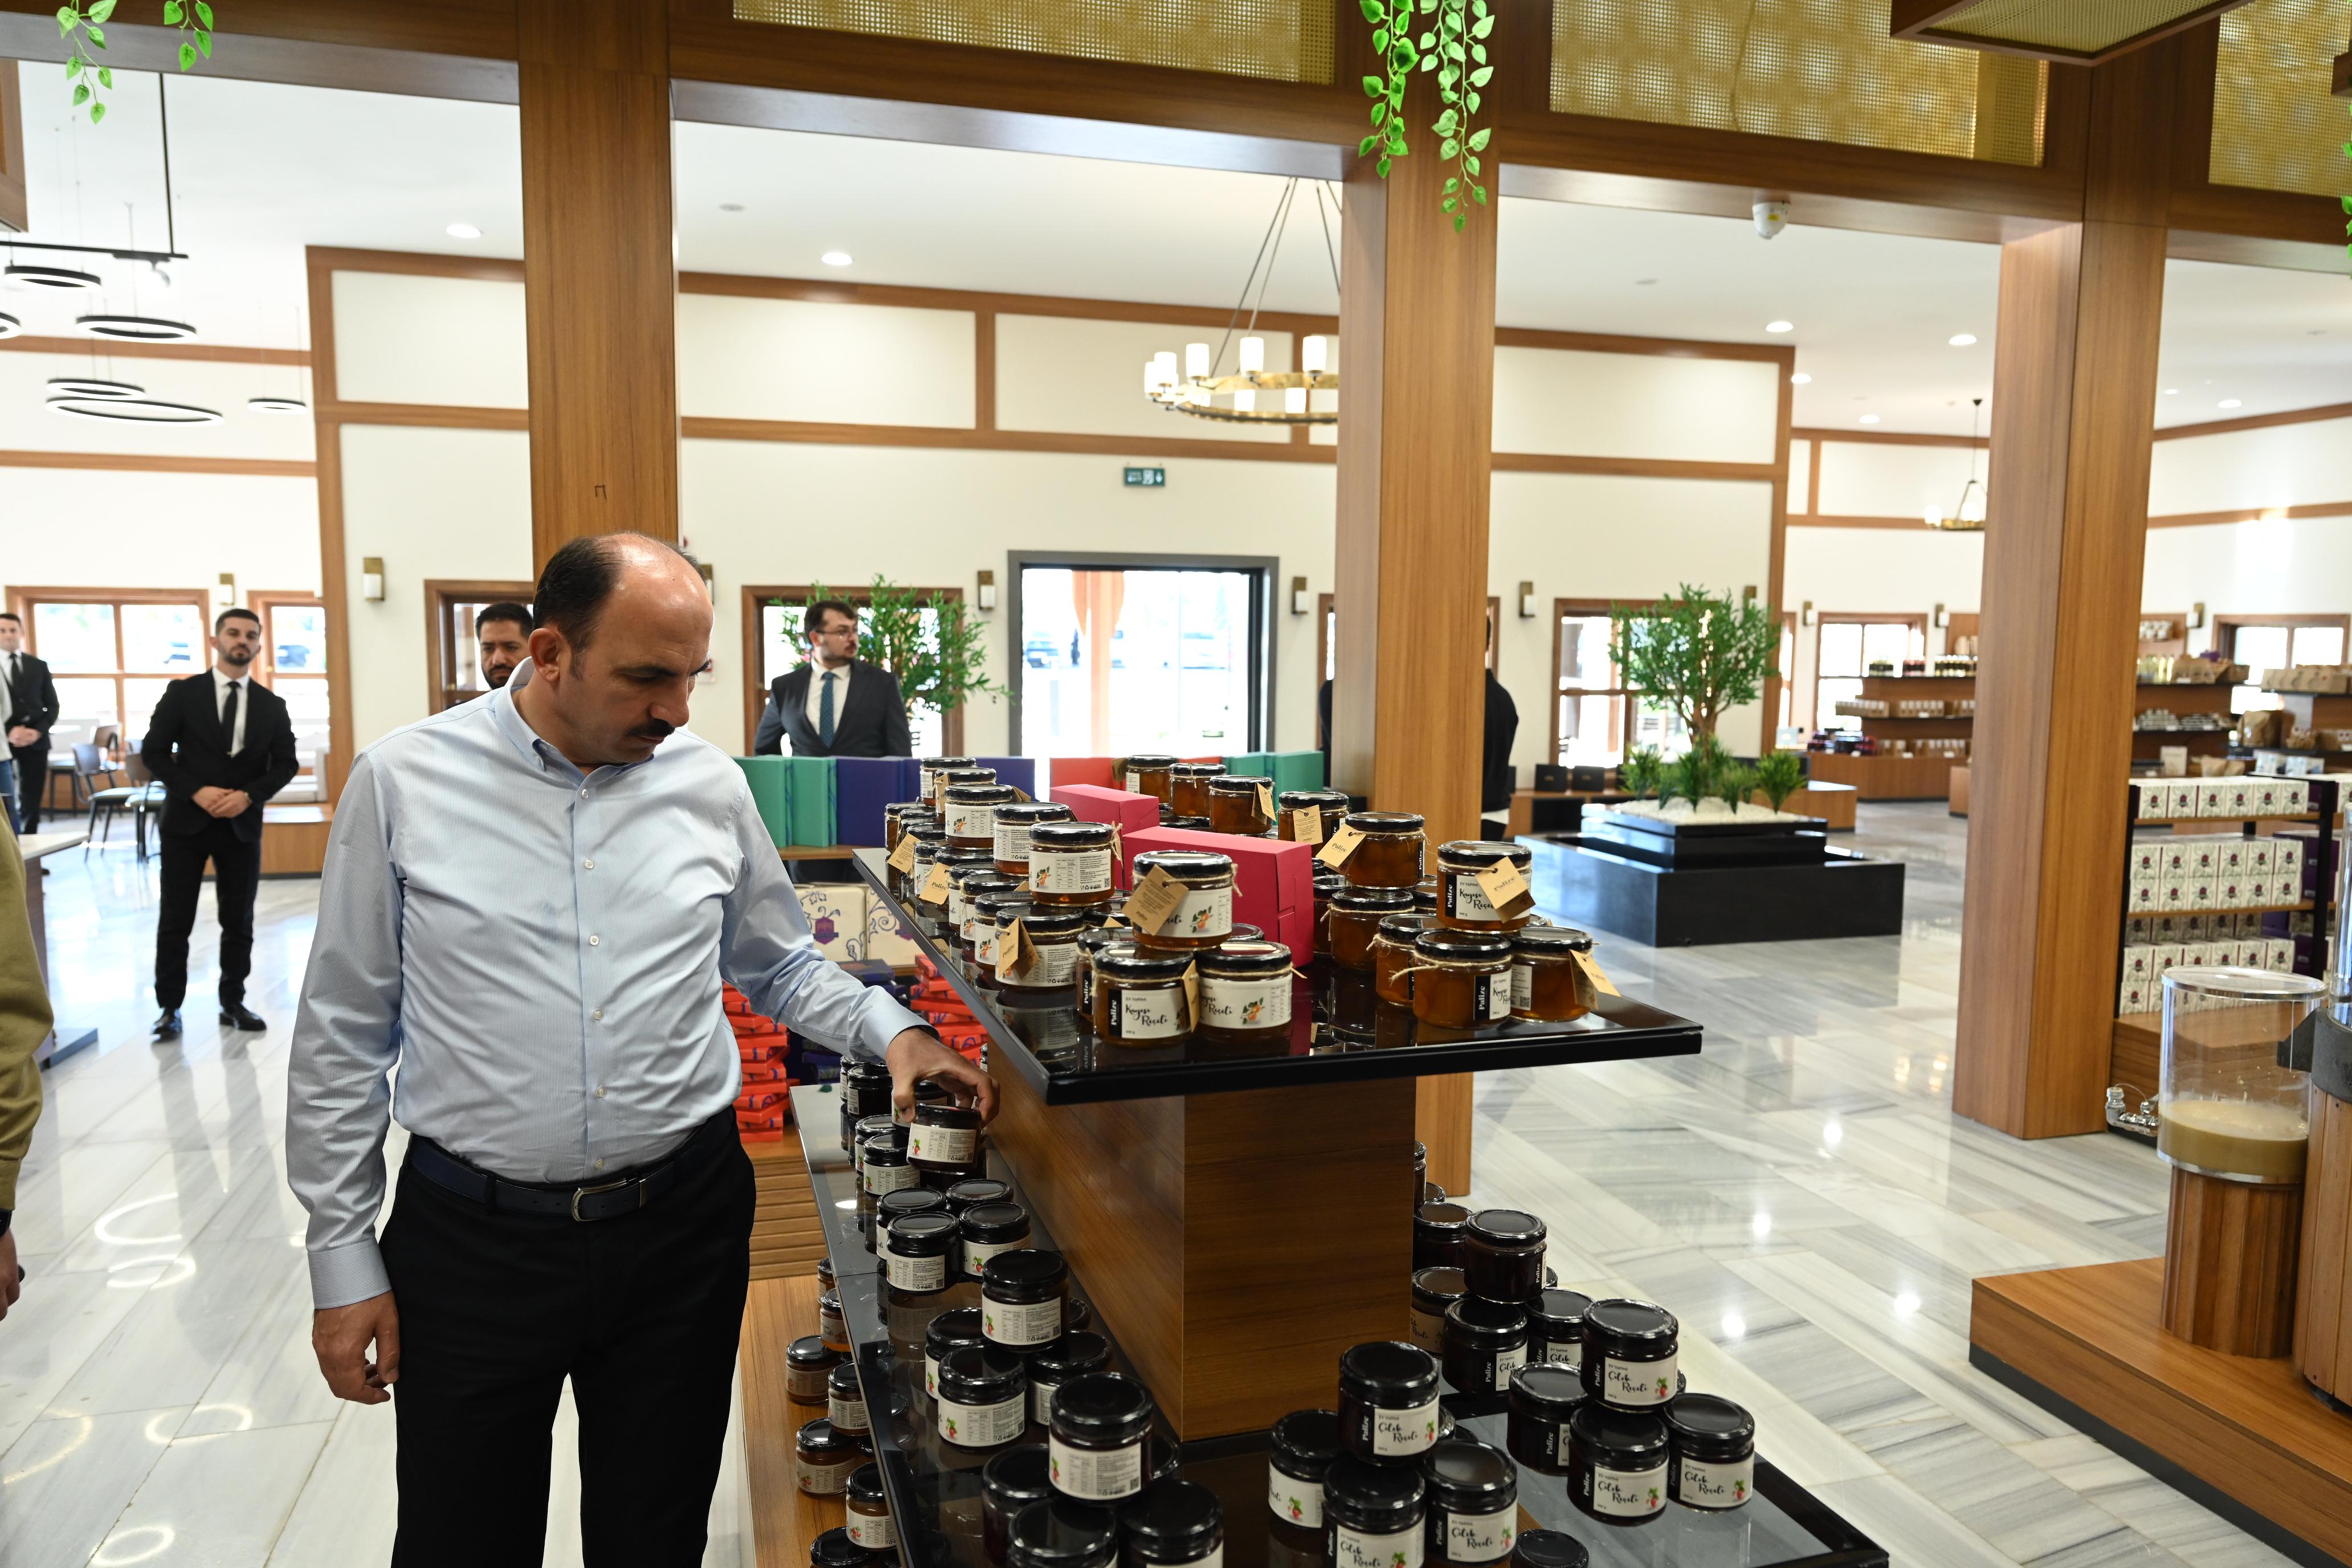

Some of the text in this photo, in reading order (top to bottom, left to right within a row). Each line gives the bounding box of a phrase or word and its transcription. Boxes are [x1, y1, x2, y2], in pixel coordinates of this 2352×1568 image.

[1332, 843, 1348, 853] Palize
[931, 881, 948, 890] Palize
[1493, 876, 1516, 892] Palize
[1473, 900, 1494, 910] Reçe
[1208, 1003, 1232, 1015] Reçeli
[1142, 1014, 1167, 1026] Reçeli
[1550, 1353, 1571, 1362] Çilek
[1608, 1370, 1632, 1382] Çilek
[1622, 1382, 1647, 1394] Reçeli
[1378, 1423, 1403, 1435] Çilek
[1393, 1431, 1418, 1443] Reçeli
[1546, 1431, 1554, 1455] Palize
[1684, 1471, 1709, 1484] Çilek
[1598, 1480, 1623, 1493] Çilek
[1698, 1483, 1725, 1495] Reçeli
[1612, 1492, 1638, 1504] Reçeli
[1451, 1526, 1475, 1539] Çilek
[1340, 1540, 1363, 1555] Çilek
[1467, 1536, 1493, 1549] Reçeli
